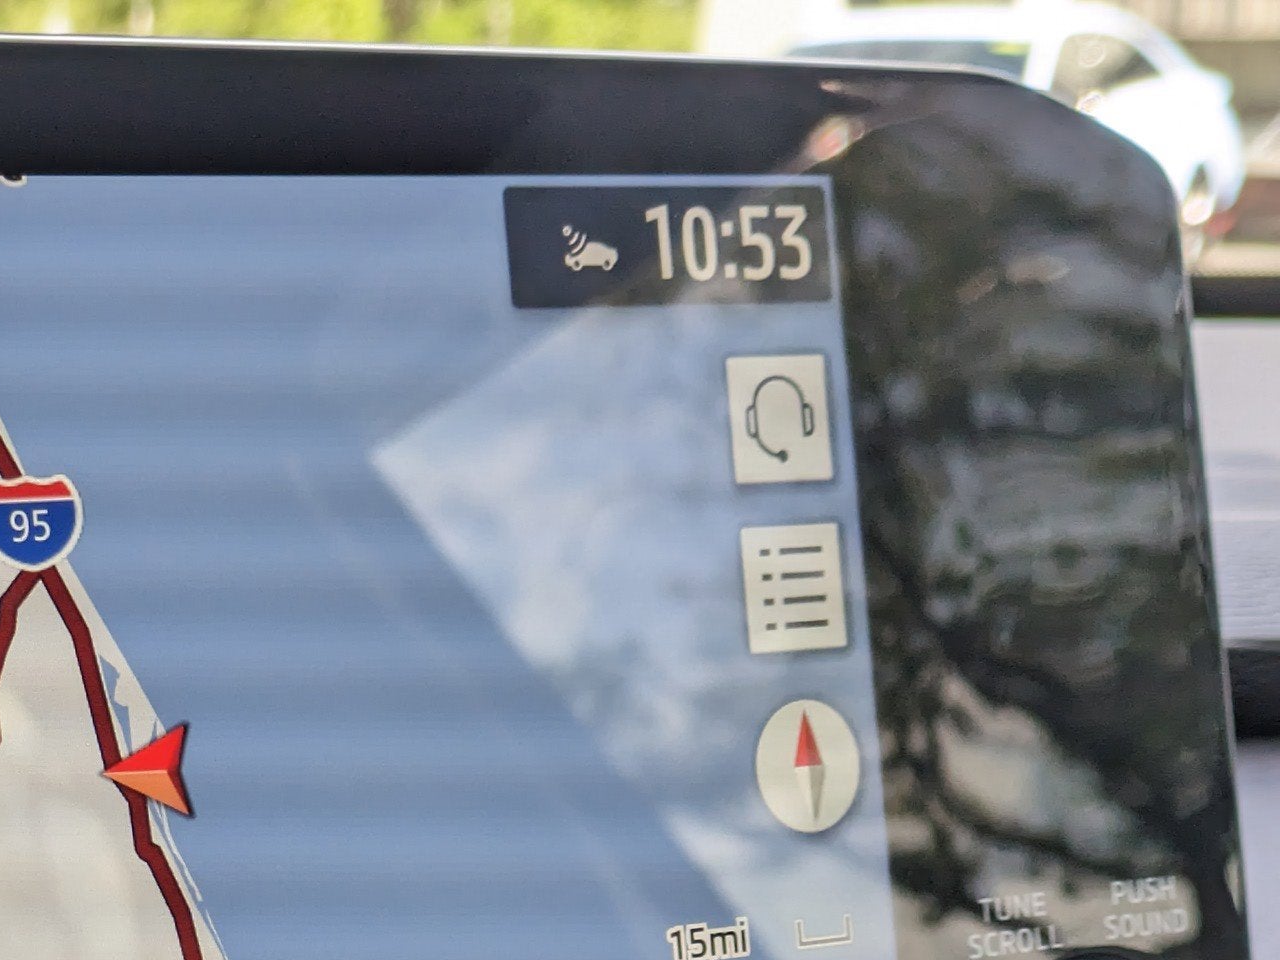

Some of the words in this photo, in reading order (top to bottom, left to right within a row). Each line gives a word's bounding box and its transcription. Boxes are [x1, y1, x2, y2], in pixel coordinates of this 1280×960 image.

[644, 203, 813, 282] 10:53
[9, 509, 51, 543] 95
[1111, 876, 1177, 906] PUSH
[977, 892, 1048, 923] TUNE
[1104, 909, 1188, 940] SOUND
[969, 925, 1063, 959] SCROLL
